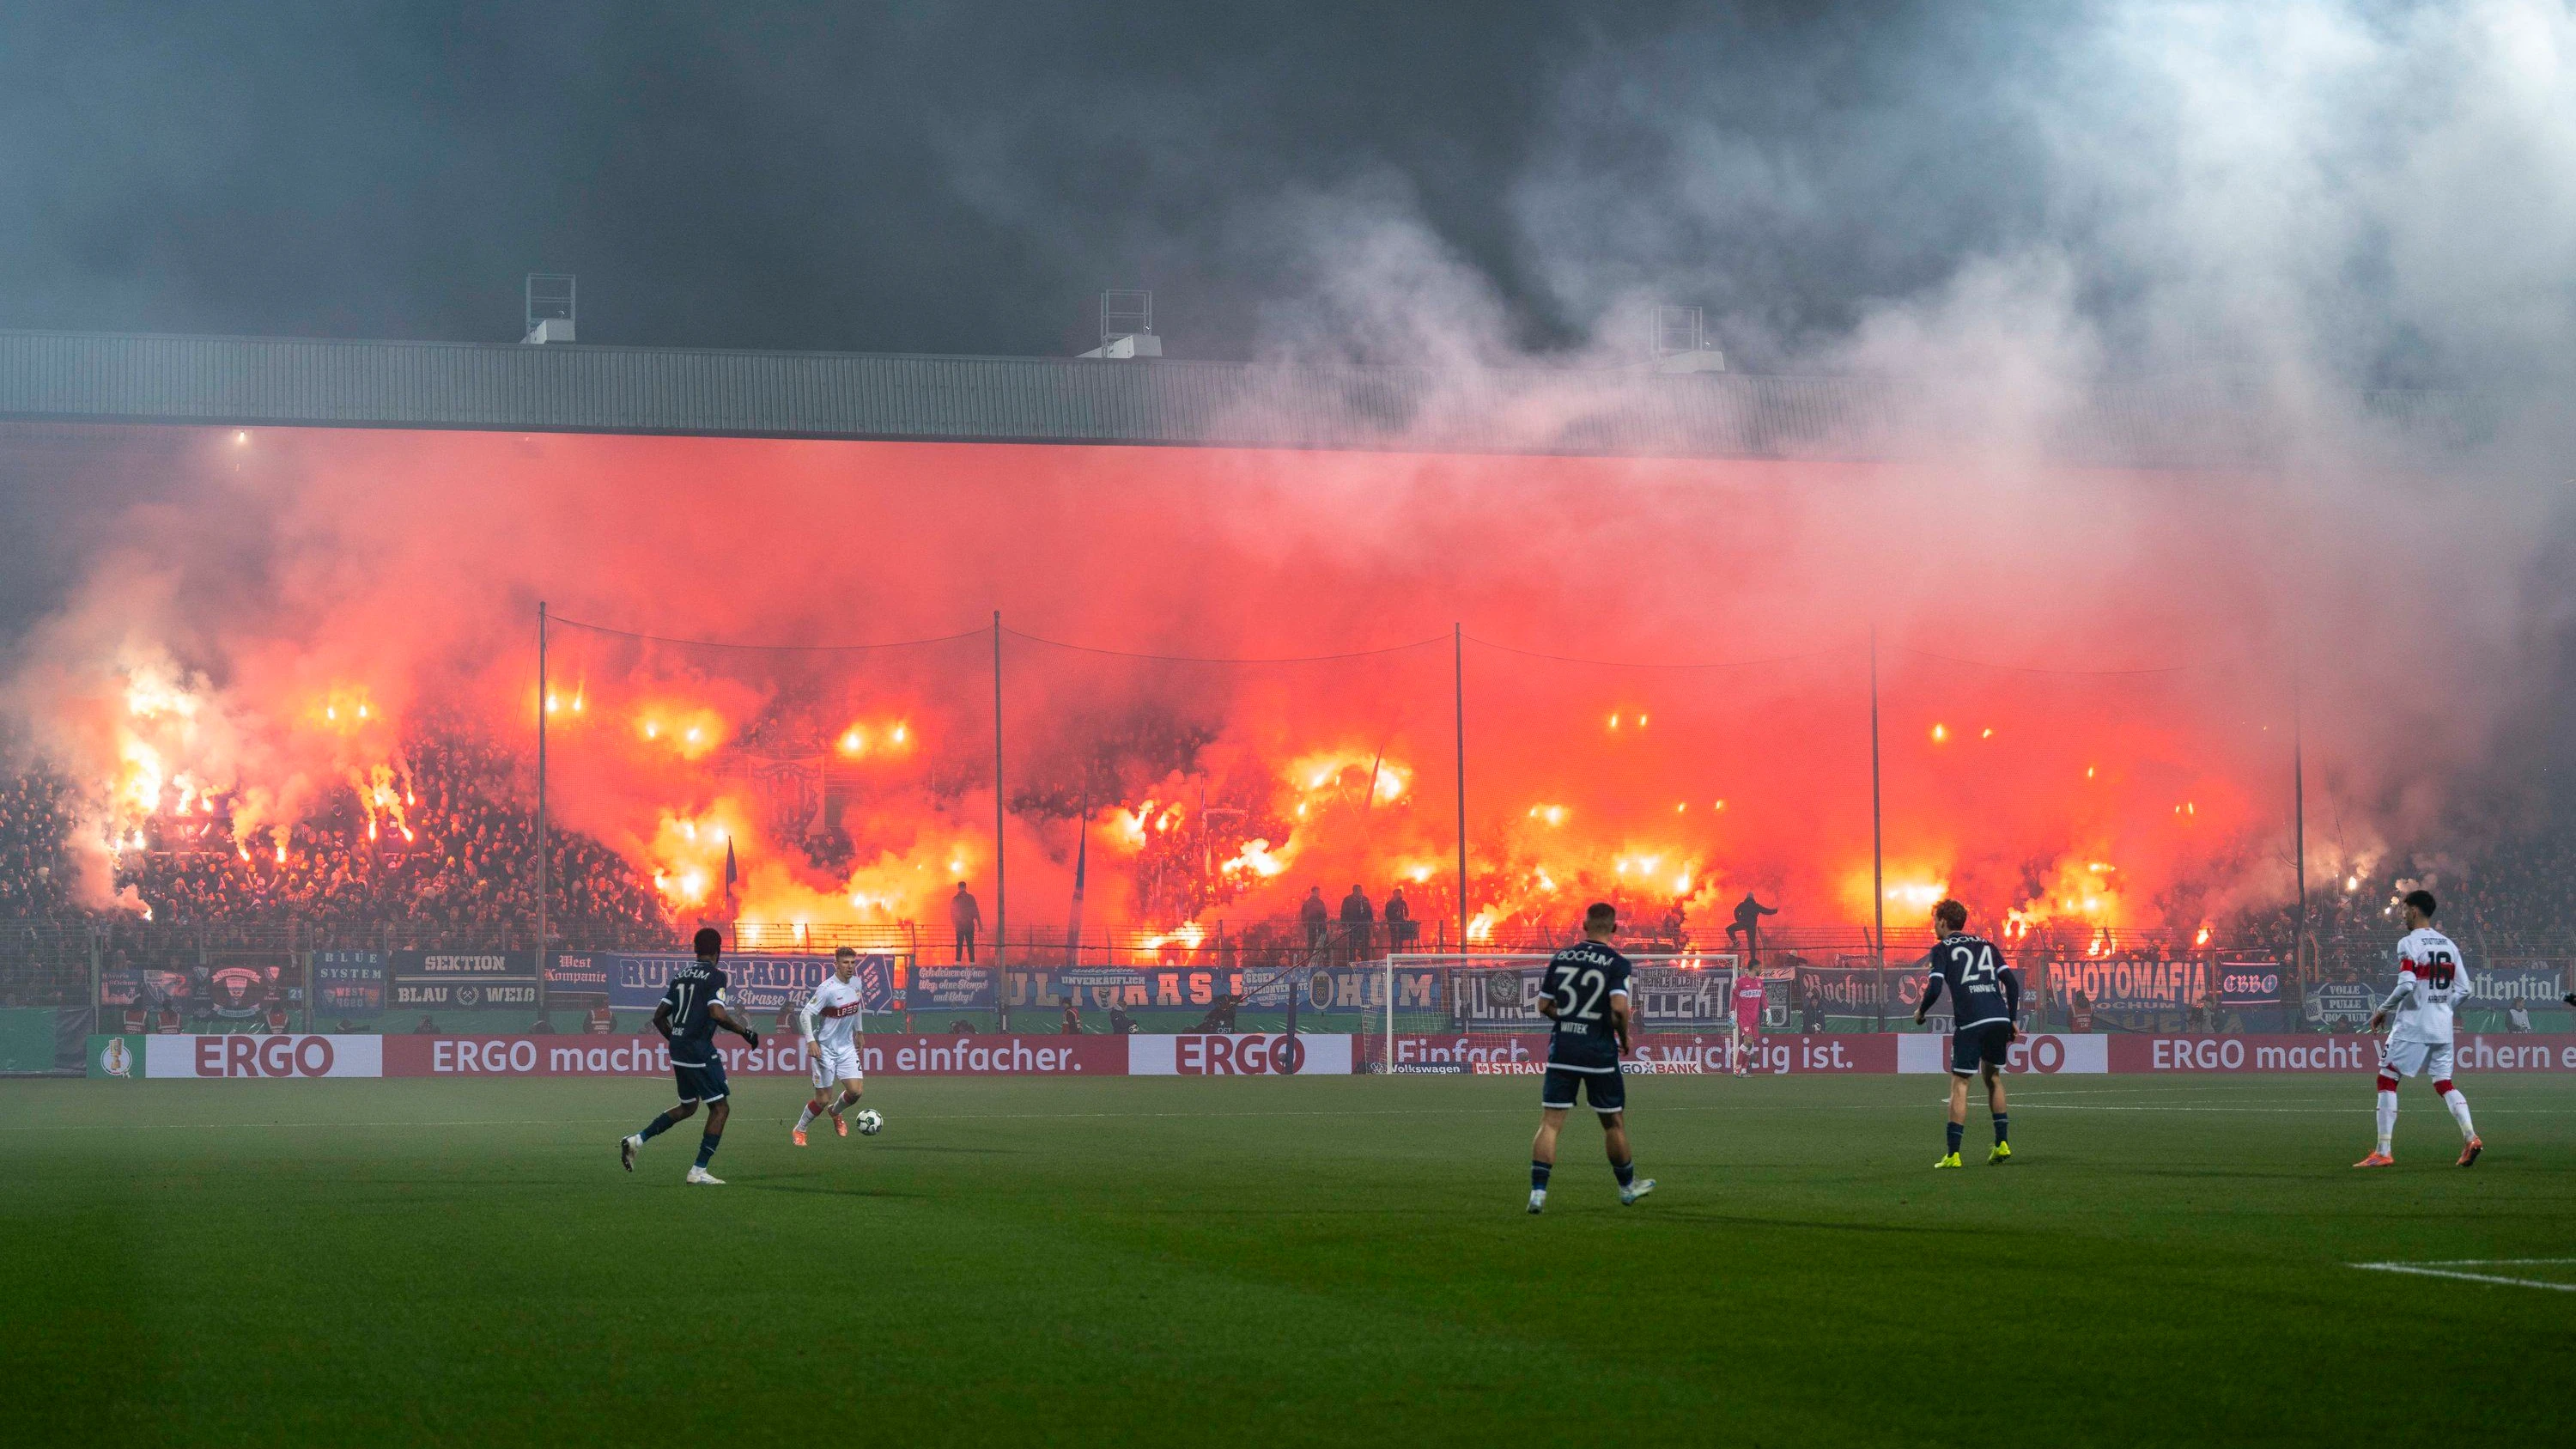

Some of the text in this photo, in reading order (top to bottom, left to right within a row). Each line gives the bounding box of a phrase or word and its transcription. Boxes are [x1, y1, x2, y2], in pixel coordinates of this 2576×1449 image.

[325, 953, 378, 963] BLUE
[425, 955, 505, 971] SEKTION
[559, 954, 592, 968] West
[1557, 950, 1614, 966] BOCHUM
[1951, 945, 1996, 985] 24
[320, 968, 381, 978] SYSTEM
[544, 969, 607, 983] Kompanie
[1061, 976, 1145, 985] UNVERKÄUFLICH
[2049, 962, 2207, 1008] PHOTOMAFIA
[289, 989, 302, 999] 21
[336, 987, 365, 996] WEST
[398, 988, 447, 1002] BLAU
[893, 989, 907, 1000] 22
[1555, 966, 1605, 1020] 32
[2024, 990, 2037, 1001] 23
[2330, 985, 2360, 995] VOLLE
[674, 983, 695, 1023] 11
[737, 989, 786, 1008] Strasse
[787, 990, 811, 1008] 145
[2329, 999, 2361, 1009] PULLE
[195, 1036, 334, 1077] ERGO
[433, 1040, 537, 1072] ERGO
[550, 1038, 671, 1072] macht
[896, 1038, 1082, 1072] einfacher.
[1176, 1036, 1305, 1075] ERGO
[1803, 1038, 1854, 1068] ist.
[2154, 1039, 2245, 1069] ERGO
[2257, 1038, 2362, 1069] macht
[1391, 1064, 1460, 1075] Volkswagen
[1492, 1062, 1546, 1074] STRAU
